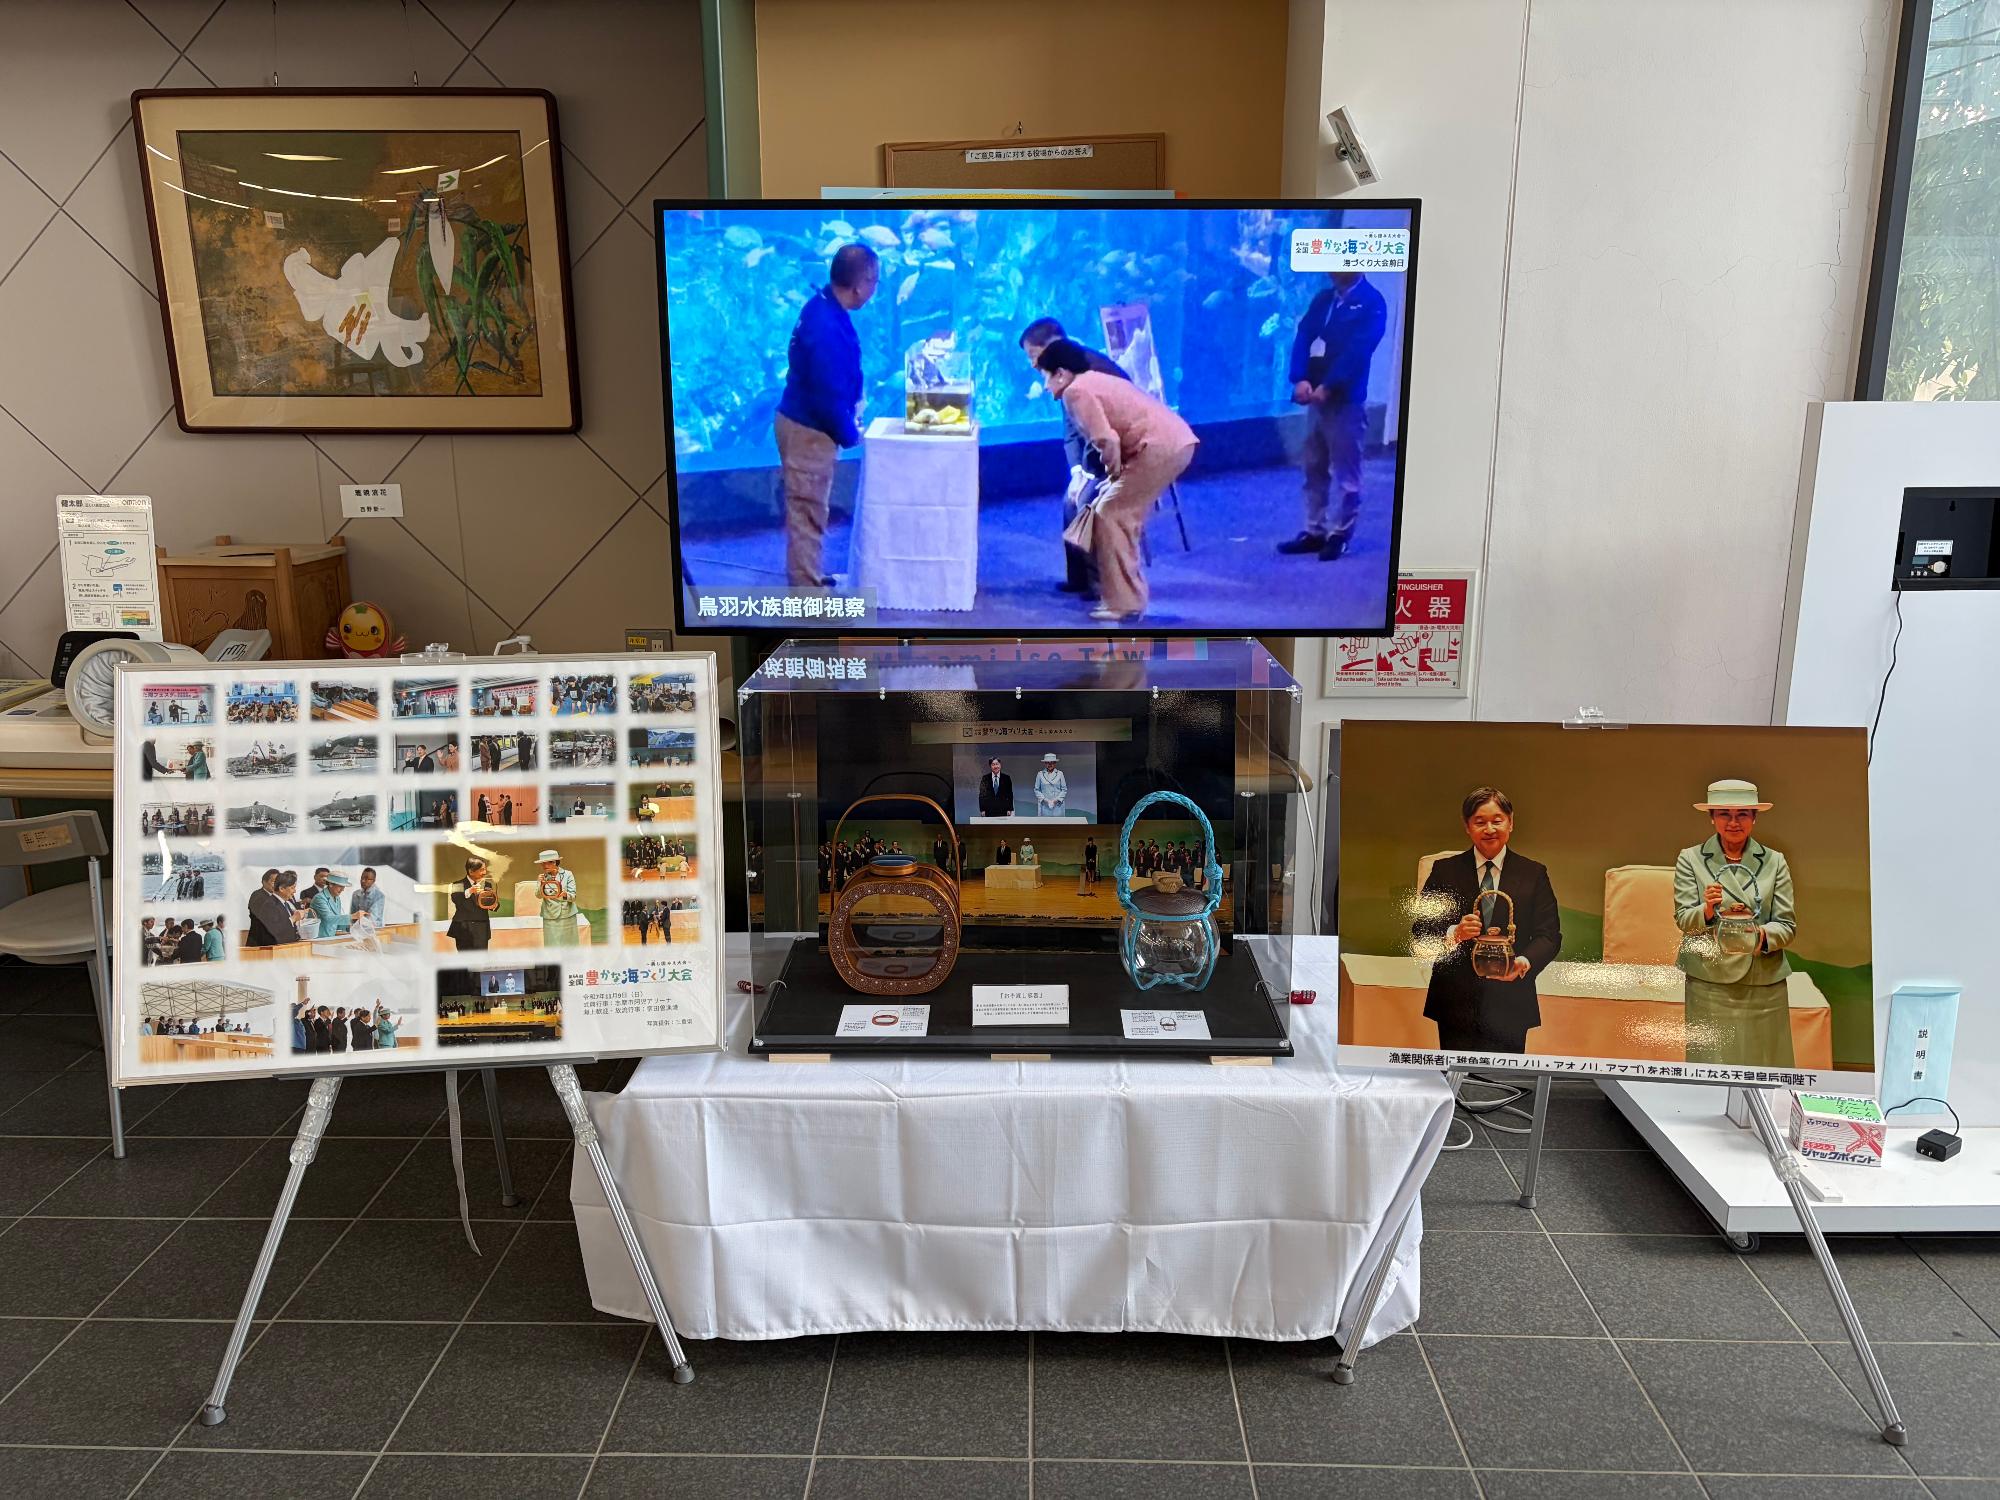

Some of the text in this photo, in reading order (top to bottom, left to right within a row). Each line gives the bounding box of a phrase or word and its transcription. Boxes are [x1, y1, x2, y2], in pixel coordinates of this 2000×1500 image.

[1310, 239, 1406, 255] 豊かな海づくり大会
[1342, 258, 1404, 268] 海づくり大会前日
[1397, 583, 1444, 591] TINGUISHER
[698, 596, 866, 618] 鳥羽水族館御視察
[1395, 596, 1452, 619] 火器
[568, 979, 584, 987] 全国
[586, 968, 693, 986] 豊かな海づくり大会
[1913, 1029, 1928, 1081] 説明書
[1815, 1120, 1840, 1128] ヤマヒロ
[1803, 1141, 1836, 1151] ステンレス
[1801, 1148, 1877, 1164] ジャックポイント
